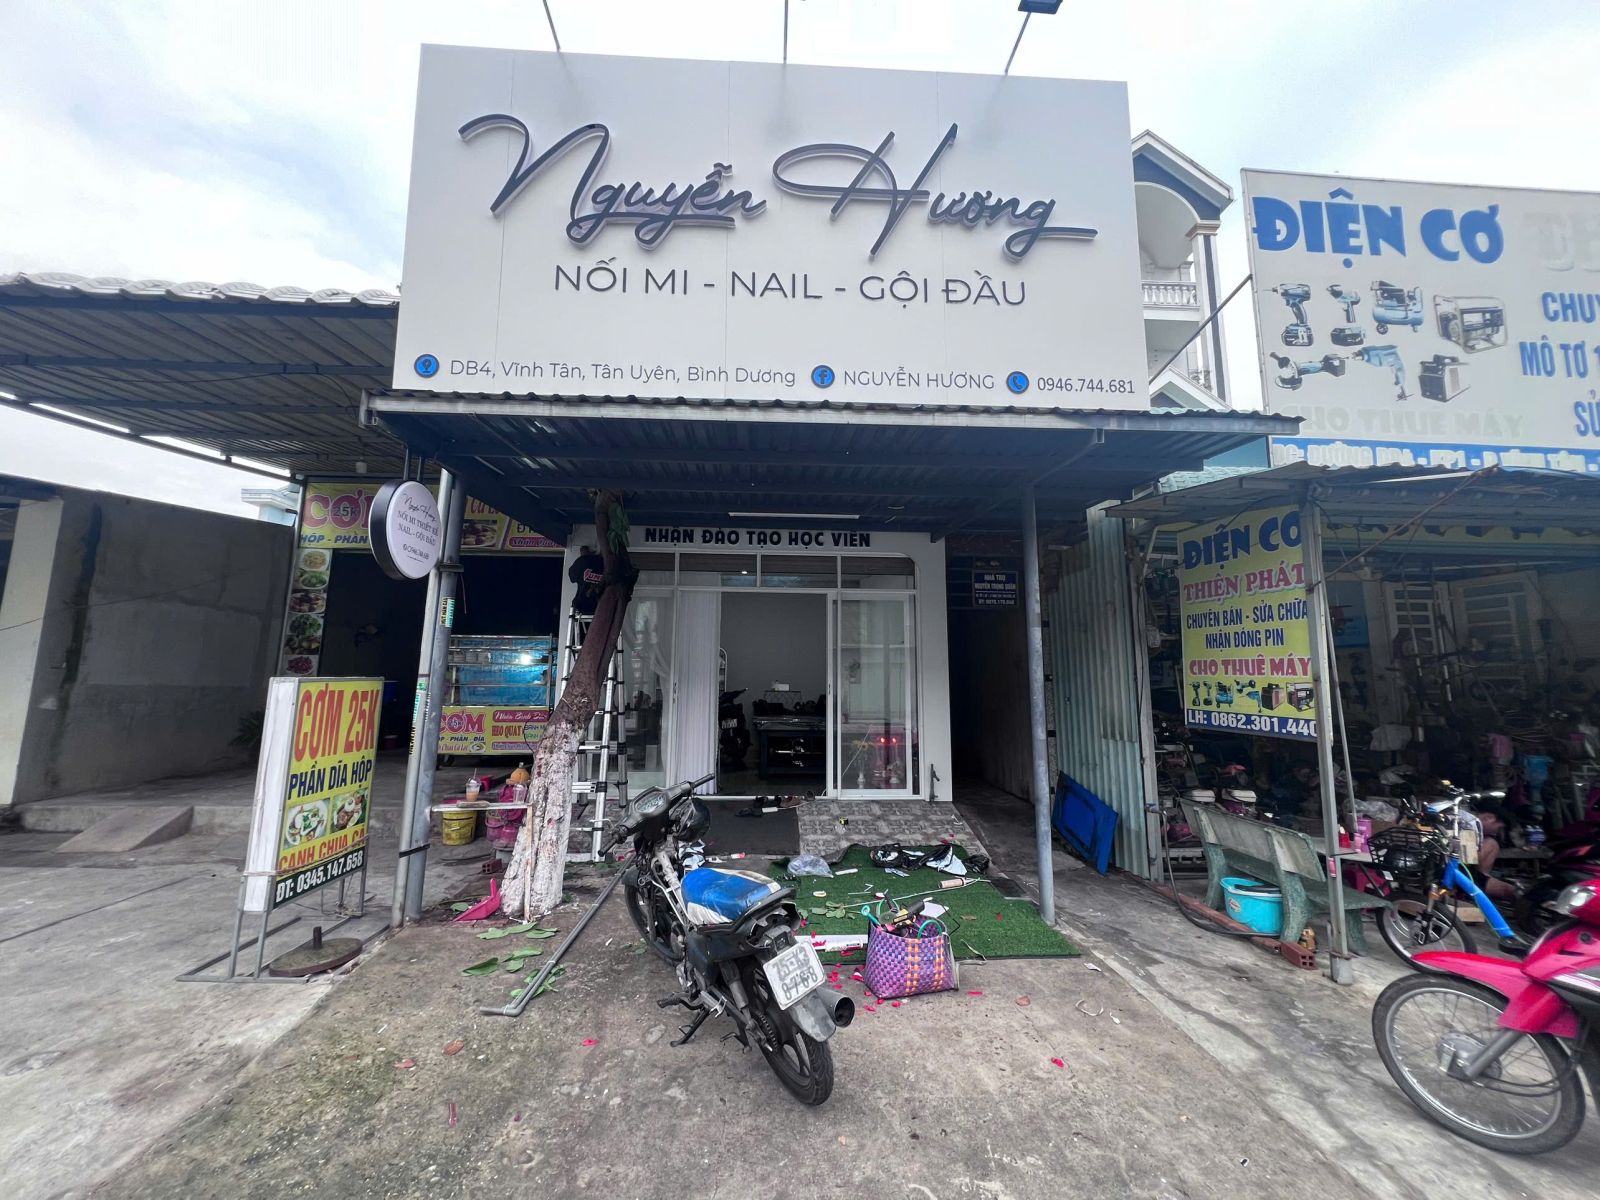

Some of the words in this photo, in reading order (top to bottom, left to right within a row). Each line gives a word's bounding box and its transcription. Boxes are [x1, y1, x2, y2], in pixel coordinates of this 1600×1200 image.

[458, 114, 767, 250] Nguyễn
[772, 123, 1098, 262] Hương
[1251, 186, 1407, 269] ĐIỆN
[1419, 203, 1505, 264] CƠ
[554, 256, 627, 293] NỐI
[644, 268, 688, 295] MI
[731, 271, 823, 299] NAIL
[859, 270, 929, 308] GỘI
[941, 269, 1027, 305] ĐẦU
[450, 360, 496, 379] DB4,
[500, 360, 544, 378] Vĩnh
[549, 361, 586, 381] Tân,
[591, 363, 625, 380] Tân
[630, 365, 681, 384] Uyên,
[687, 365, 730, 383] Bình
[735, 367, 797, 388] Dương
[844, 366, 920, 388] NGUYỄN
[926, 371, 995, 390] HƯƠNG
[1518, 334, 1557, 378] MÔ
[1558, 340, 1589, 380] TƠ
[1037, 377, 1136, 395] 0946.744.681
[644, 526, 695, 546] NHẬN
[701, 527, 740, 545] ĐÀO
[746, 530, 782, 549] TẠO
[788, 530, 824, 550] HỌC
[831, 530, 871, 548] VIÊN
[1182, 524, 1251, 570] ĐIỆN
[1183, 572, 1239, 602] THIỆN
[1245, 559, 1306, 593] PHÁT
[1186, 608, 1221, 630] CHUYÊN
[1222, 605, 1243, 626] BÁN
[1252, 599, 1275, 624] SỬA
[1205, 628, 1231, 653] NHẬN
[1264, 627, 1285, 647] PIN
[1188, 657, 1219, 677] CHO
[1221, 652, 1266, 677] THUÊ
[1269, 651, 1312, 677] MÁY
[294, 682, 345, 762] CƠM
[344, 688, 380, 754] 25K
[287, 760, 326, 801] PHẦN
[350, 754, 373, 788] HỘP
[277, 845, 316, 872] CANH
[318, 833, 349, 859] CHUA
[296, 849, 364, 894] 0345.147.658
